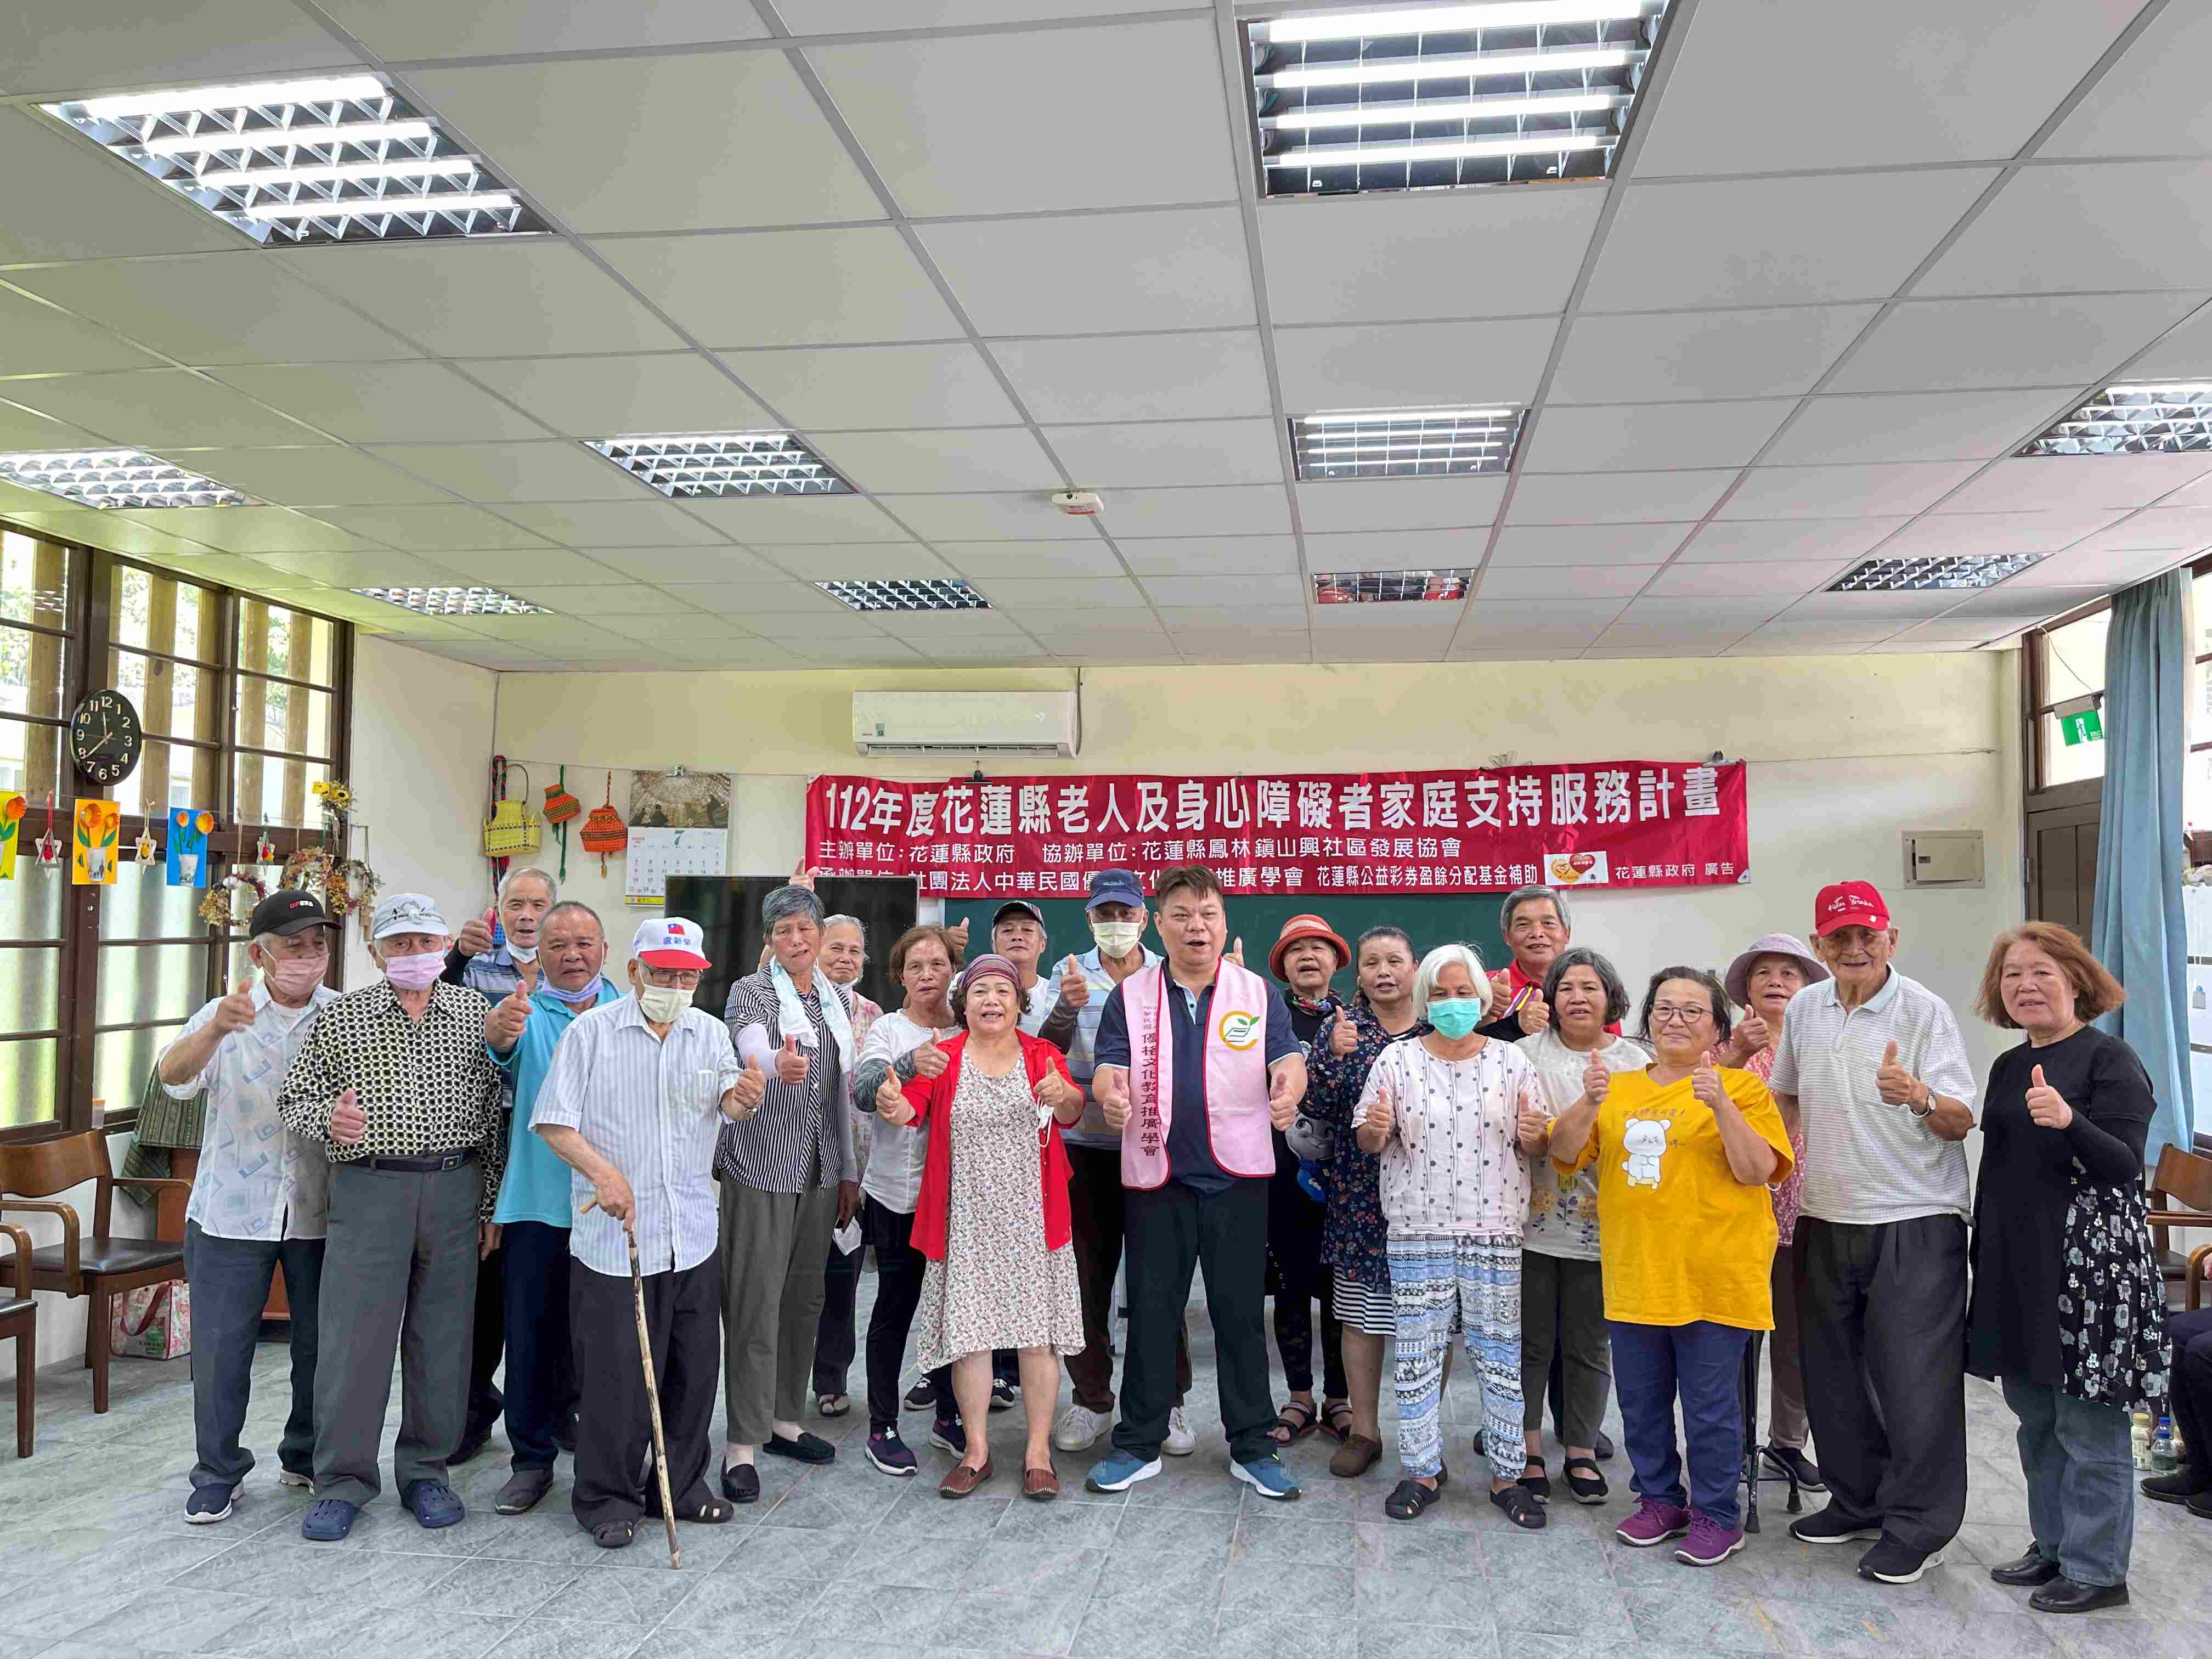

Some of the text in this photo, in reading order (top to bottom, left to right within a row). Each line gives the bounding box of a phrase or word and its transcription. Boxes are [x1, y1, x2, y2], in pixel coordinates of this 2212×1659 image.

[89, 700, 99, 712] 11
[100, 696, 112, 708] 12
[116, 703, 121, 715] 1
[80, 712, 91, 725] 10
[122, 716, 131, 728] 2
[77, 729, 84, 741] 9
[124, 735, 132, 747] 3
[78, 748, 86, 759] 8
[120, 753, 128, 764] 4
[86, 761, 95, 773] 7
[111, 765, 120, 776] 5
[99, 768, 107, 780] 6
[826, 767, 1720, 837] 112年度花蓮縣老人及身心障礙者家庭支持服務計畫
[674, 830, 685, 845] 7
[1317, 864, 1538, 888] 花蓮縣公益彩券盈餘分配基金補助
[1615, 864, 1696, 880] 花蓮縣政府
[1705, 862, 1734, 877] 廣告
